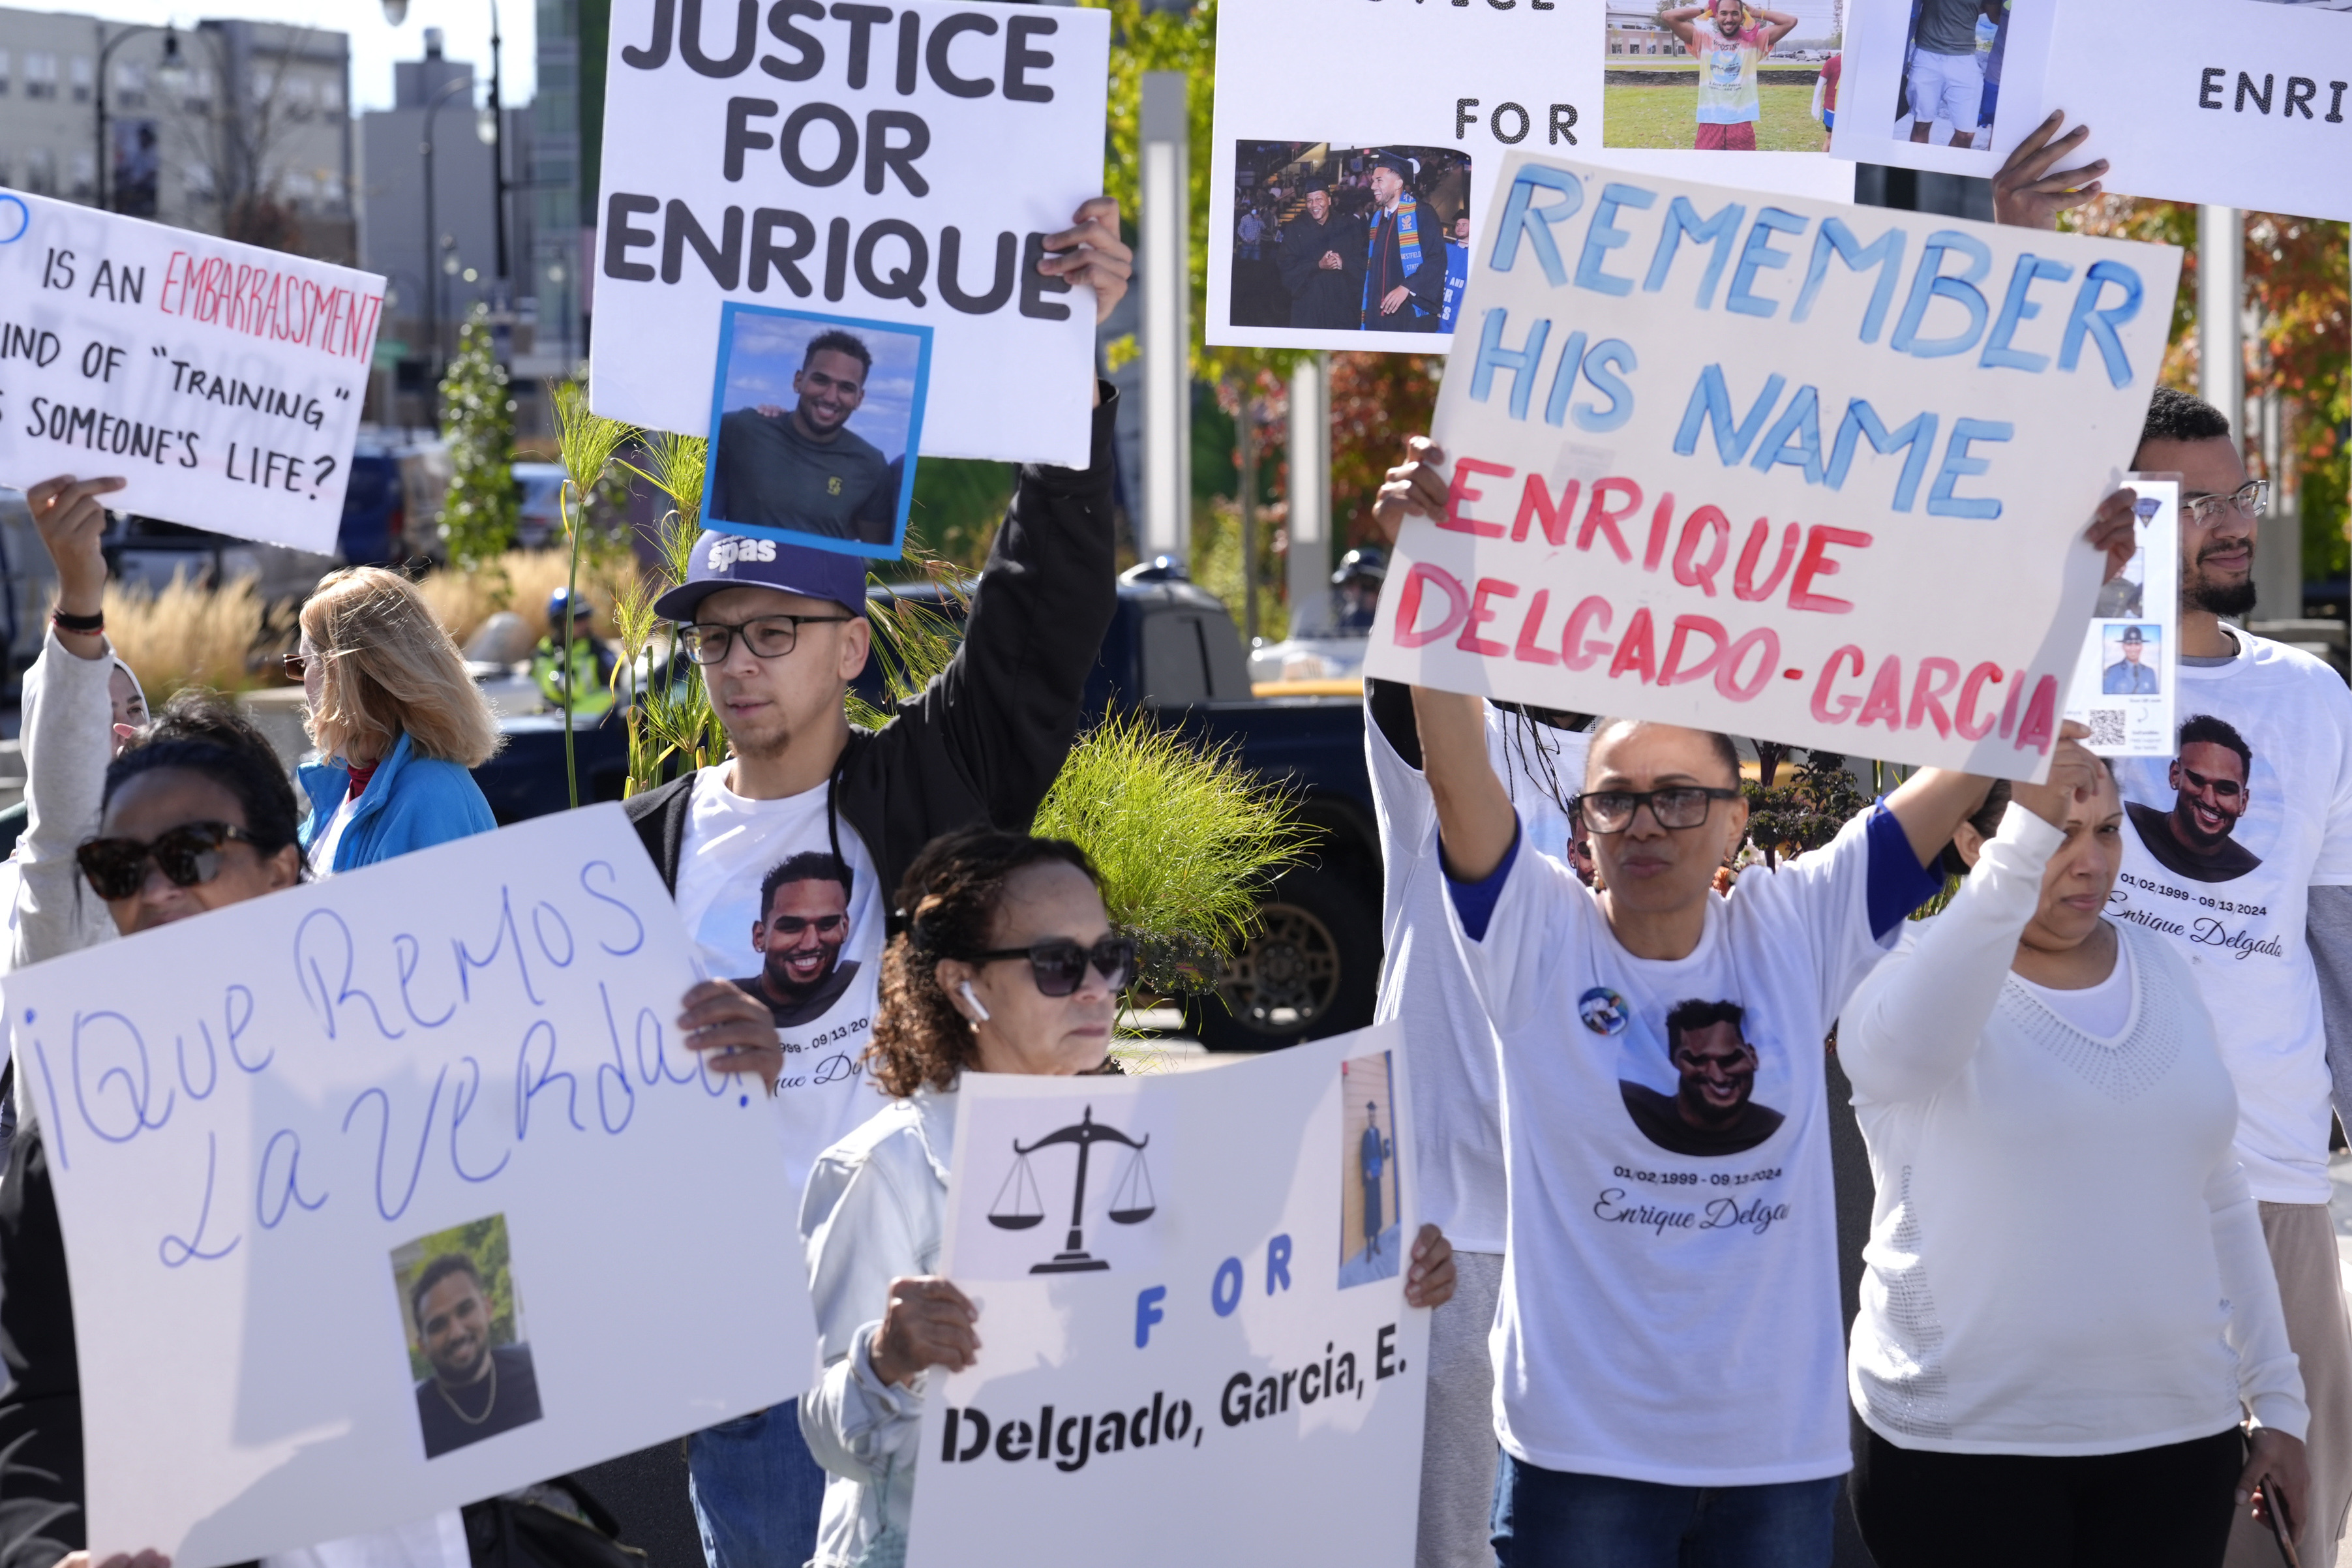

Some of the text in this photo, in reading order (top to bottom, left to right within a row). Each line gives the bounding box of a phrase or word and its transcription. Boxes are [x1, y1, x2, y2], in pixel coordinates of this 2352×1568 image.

[621, 0, 1059, 103] JUSTICE
[1455, 98, 1578, 146] FOR
[2199, 67, 2348, 123] ENRI
[723, 97, 931, 198] FOR
[603, 192, 1074, 322] ENRIQUE
[1449, 277, 1465, 289] AND
[1490, 162, 2145, 390] REMEMBER
[42, 247, 384, 365] IS AN EMBARRASSMENT
[82, 340, 127, 383] OF
[26, 396, 202, 469] SOMEONE'S
[226, 441, 337, 501] LIFE?
[1470, 307, 2015, 520] HIS NAME
[707, 539, 777, 573] spas
[1435, 456, 1874, 613] ENRIQUE
[1393, 562, 2058, 755] DELGADO-GARCIA
[2120, 873, 2190, 901] 01/02/1999
[2199, 896, 2268, 916] 09/13/2024
[2190, 917, 2283, 960] Delgado
[811, 1017, 870, 1049] 09/13/20
[1593, 1187, 1792, 1236] Enrique Delga
[1613, 1166, 1698, 1185] 01/02/1999
[941, 1323, 1408, 1473] Delgado, Garcia, E.
